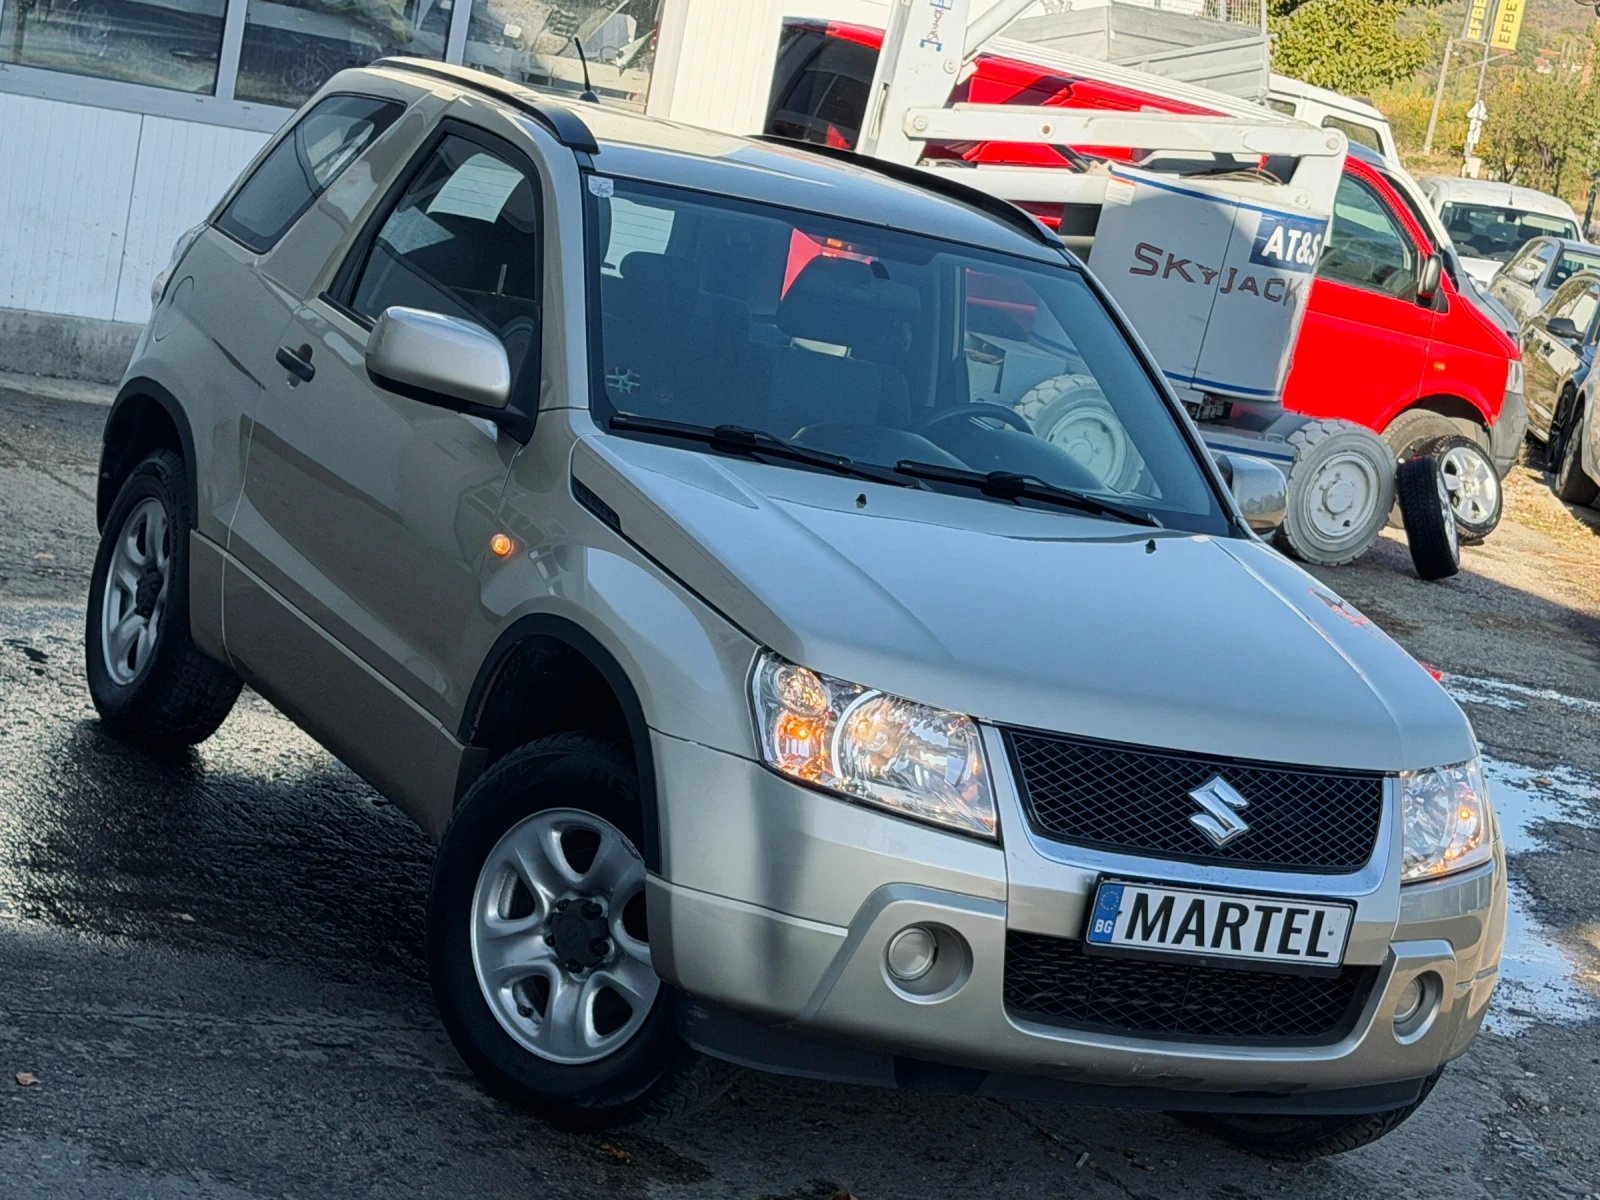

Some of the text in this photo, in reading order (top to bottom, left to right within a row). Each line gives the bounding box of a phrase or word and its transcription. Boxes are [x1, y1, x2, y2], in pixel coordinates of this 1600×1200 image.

[1498, 0, 1517, 44] EFBE
[1261, 225, 1322, 266] AT&S
[1129, 242, 1304, 308] SKYJACK
[1094, 918, 1113, 934] BG
[1124, 892, 1330, 958] MARTEL
